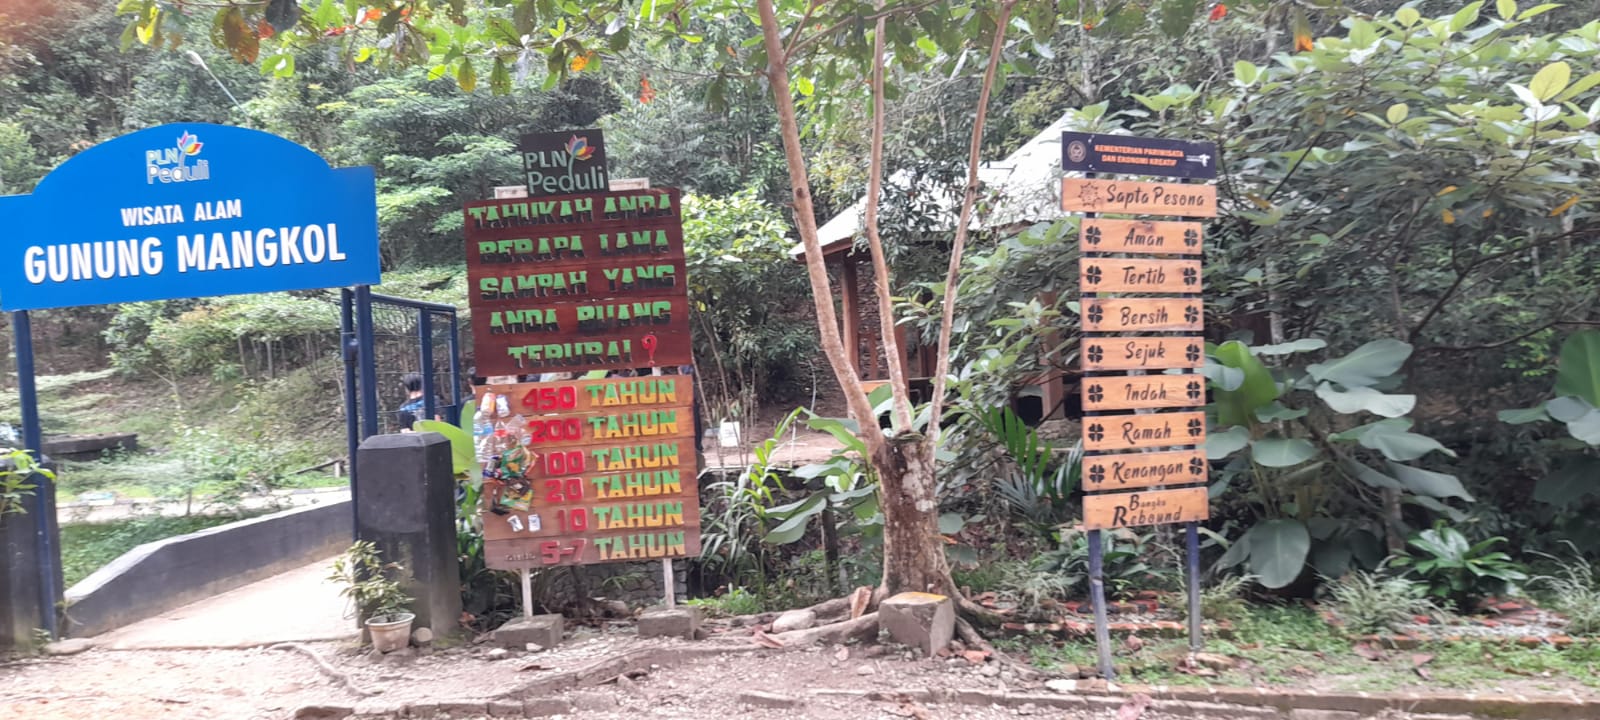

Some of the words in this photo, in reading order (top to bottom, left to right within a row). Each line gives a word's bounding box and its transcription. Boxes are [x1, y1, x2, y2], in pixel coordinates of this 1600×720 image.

[146, 147, 178, 165] PLN
[524, 150, 568, 169] PLN
[146, 160, 209, 184] Peduli
[527, 165, 606, 194] Peduli
[1106, 184, 1149, 209] Sapta
[1152, 186, 1205, 207] Pesona
[121, 204, 184, 227] WISATA
[194, 199, 242, 221] ALAM
[468, 197, 593, 229] TAHUKAH
[602, 193, 674, 222] ANDA
[478, 235, 586, 264] BERAPA
[599, 229, 671, 257] LAMA
[1123, 227, 1165, 247] Aman
[24, 237, 163, 284] GUNUNG
[177, 223, 346, 273] MANGKOL
[479, 270, 588, 300] SAMPAH
[603, 264, 676, 292] YANG
[1122, 265, 1166, 285] Tertib
[490, 308, 560, 335] ANDA
[576, 301, 672, 335] BUANG
[1120, 306, 1168, 326] Bersih
[508, 339, 633, 369] TERURAI
[641, 334, 658, 366] ?
[1125, 341, 1166, 366] Sejuk
[521, 385, 577, 411] 450
[585, 379, 678, 407] TAHUN
[1124, 383, 1167, 401] Indah
[528, 417, 583, 443] 200
[588, 410, 679, 439] TAHUN
[1122, 421, 1172, 445] Ramah
[539, 450, 585, 476] 100
[592, 442, 680, 472] TAHUN
[1112, 462, 1183, 484] Kenangan
[545, 477, 584, 503] 20
[592, 469, 682, 499] TAHUN
[1112, 505, 1183, 527] Rebound
[1129, 494, 1167, 511] Bangka
[556, 508, 588, 533] 10
[593, 501, 684, 530] TAHUN
[540, 537, 588, 565] 5-7
[594, 531, 686, 561] TAHUN
